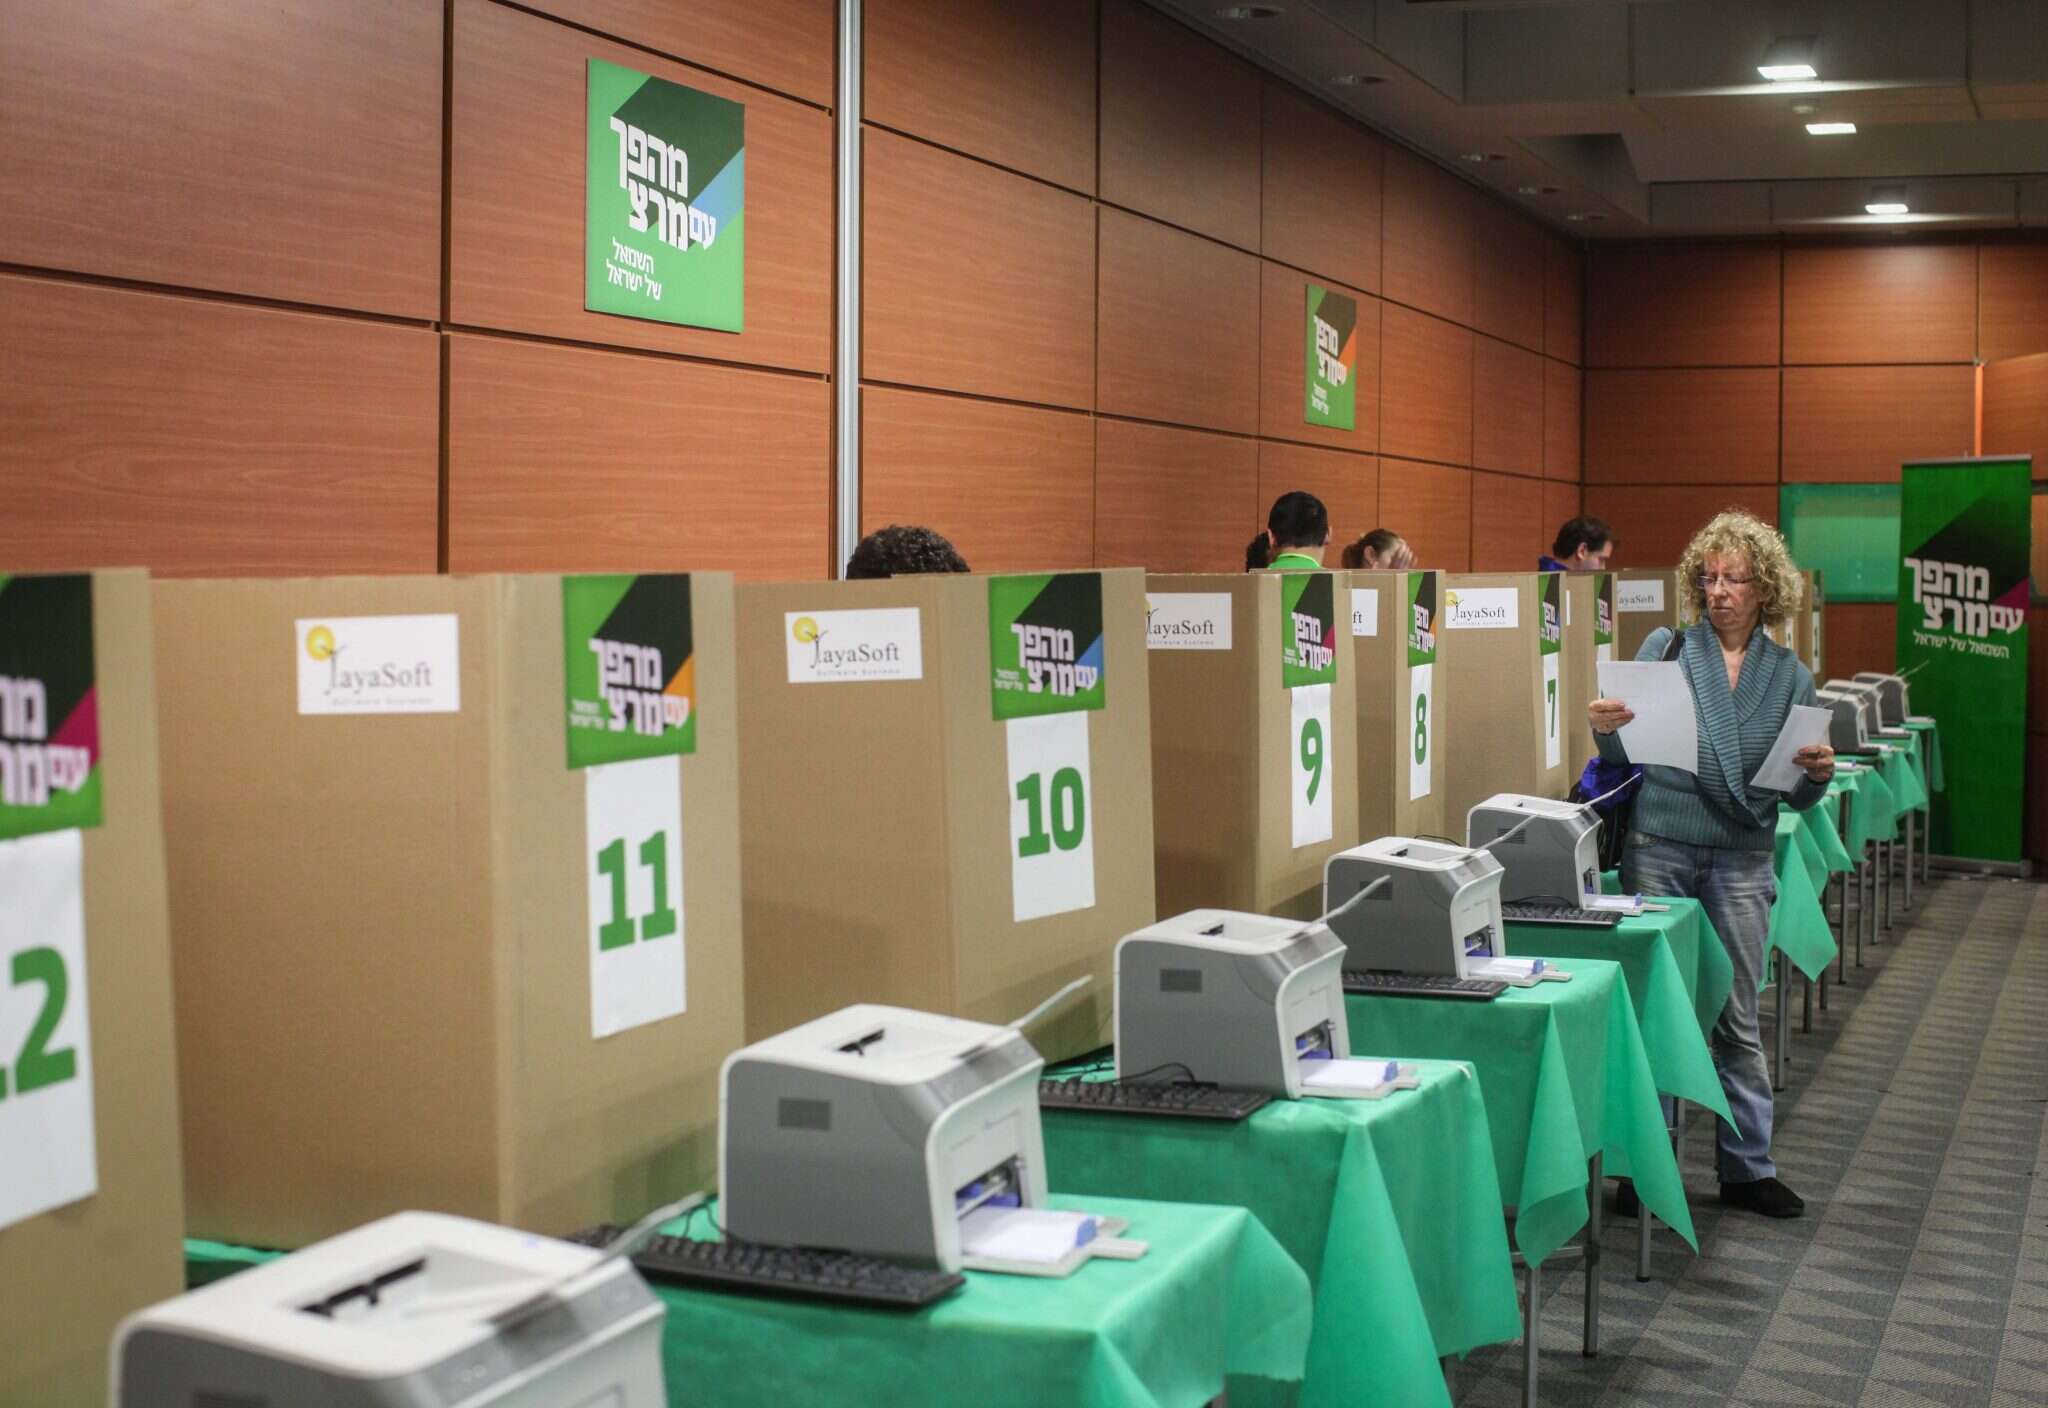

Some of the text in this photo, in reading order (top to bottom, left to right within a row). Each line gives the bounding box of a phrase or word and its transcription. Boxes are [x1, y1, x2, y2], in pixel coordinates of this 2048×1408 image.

[610, 116, 688, 198] מהפך
[629, 179, 716, 253] עם מרצ
[606, 258, 662, 301] של ישראל
[612, 236, 654, 276] השמאל
[1618, 595, 1655, 606] ayaSoft
[1904, 557, 1990, 604] מהפך
[1452, 601, 1506, 622] JayaSoft
[1922, 594, 2025, 638] עם מרצ
[810, 633, 900, 668] JayaSoft
[1011, 622, 1075, 669] מהפך
[1949, 635, 1967, 652] של
[323, 648, 432, 696] JayaSoft
[588, 637, 662, 699] מהפך
[1027, 659, 1076, 697] מרצ
[607, 688, 664, 737] מרצ
[1415, 693, 1427, 765] 8
[1547, 679, 1557, 738] 7
[1301, 717, 1324, 806] 9
[1016, 767, 1085, 858] 10
[597, 829, 677, 952] 11
[0, 946, 77, 1100] 2
